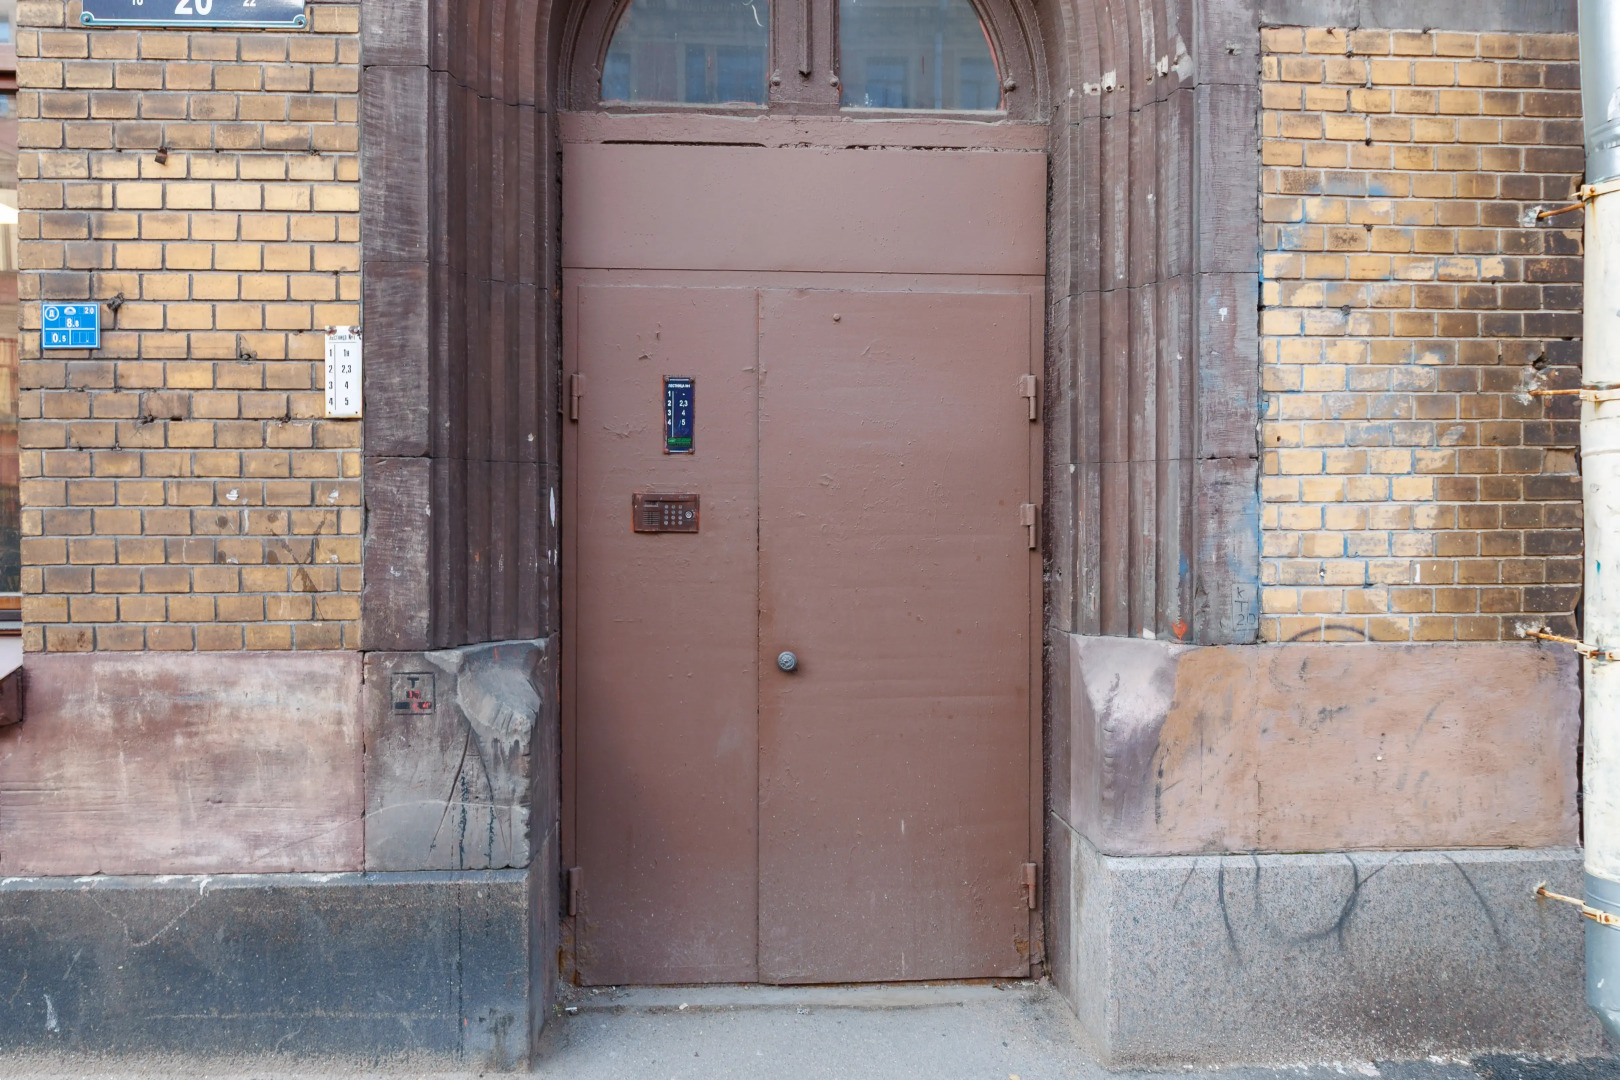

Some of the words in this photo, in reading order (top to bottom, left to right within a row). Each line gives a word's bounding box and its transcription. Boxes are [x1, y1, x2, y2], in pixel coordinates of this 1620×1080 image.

[174, 0, 213, 15] 20
[84, 306, 95, 315] 20
[328, 364, 333, 374] 2
[341, 364, 352, 375] 2,3
[328, 381, 334, 390] 3
[344, 381, 349, 390] 4
[667, 390, 672, 398] 1
[328, 397, 334, 406] 4
[344, 397, 349, 406] 5
[667, 399, 672, 407] 2
[679, 399, 689, 408] 2,3
[667, 418, 672, 426] 4
[681, 418, 686, 426] 5
